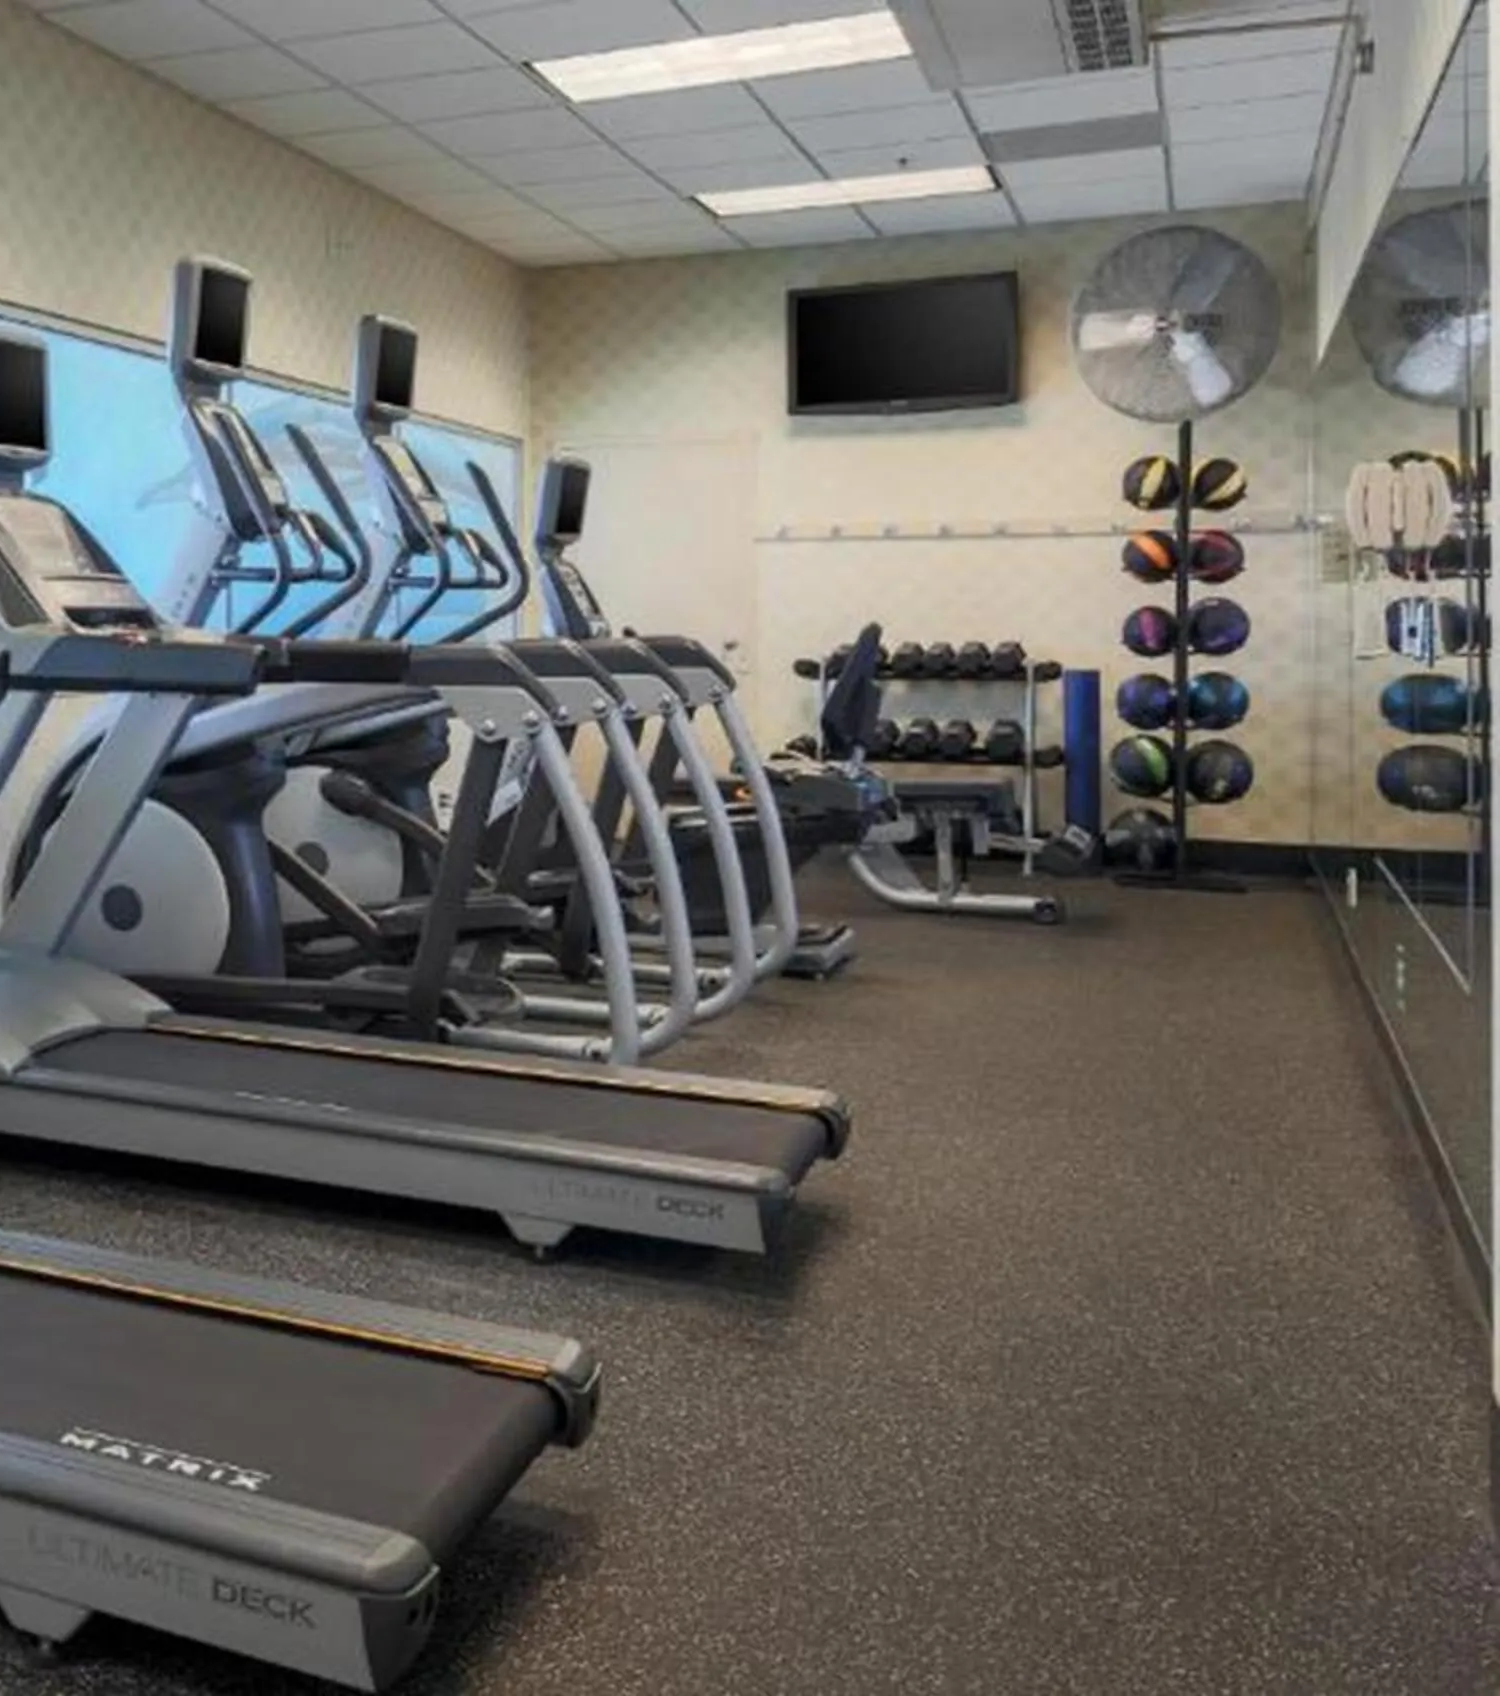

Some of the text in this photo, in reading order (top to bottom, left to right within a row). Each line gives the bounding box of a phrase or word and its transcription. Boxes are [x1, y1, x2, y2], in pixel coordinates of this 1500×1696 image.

[59, 1431, 263, 1491] MATRIX
[26, 1524, 318, 1630] ULTIMATE DECK
